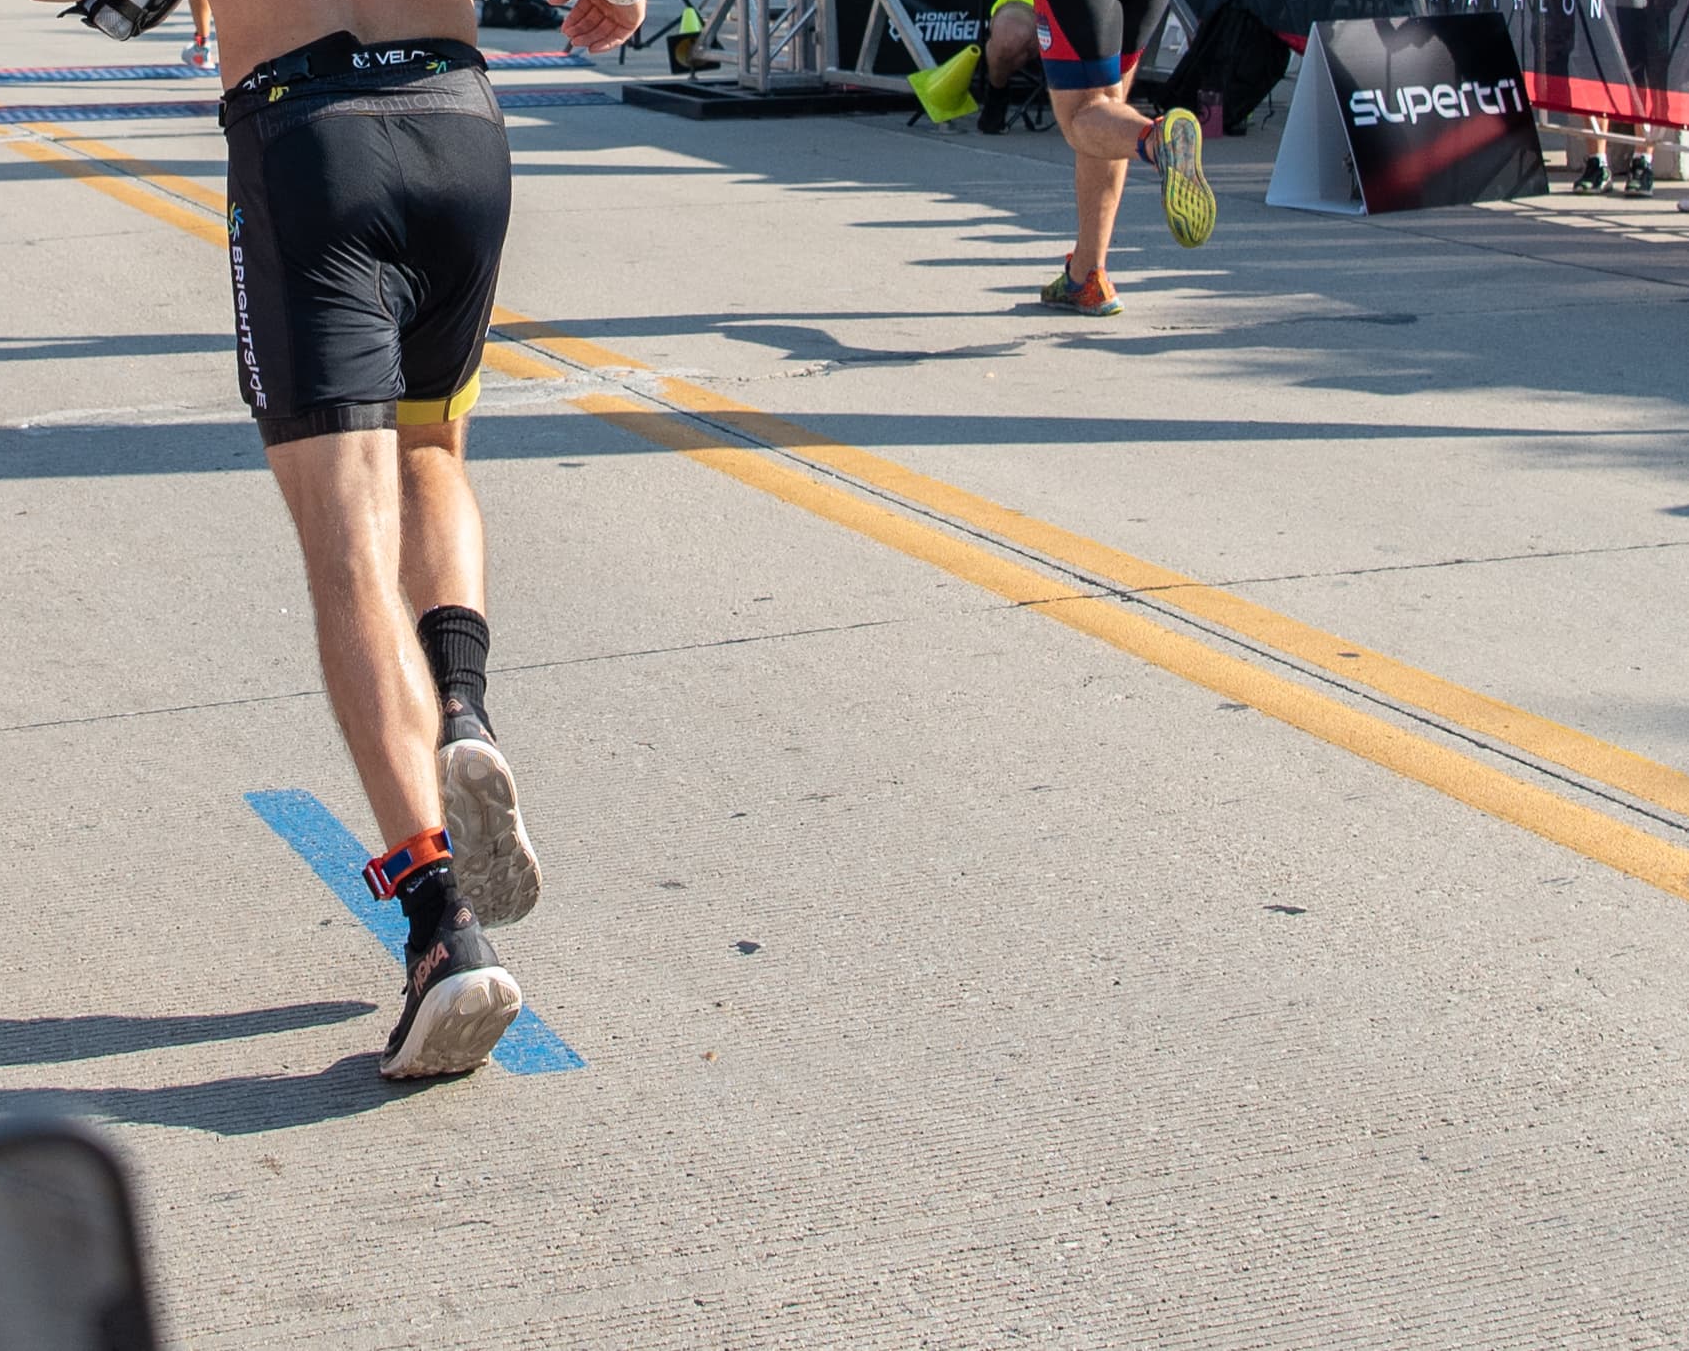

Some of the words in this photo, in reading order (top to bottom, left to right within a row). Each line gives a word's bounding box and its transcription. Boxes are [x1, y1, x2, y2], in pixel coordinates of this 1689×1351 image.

[915, 11, 969, 22] HONEY
[1349, 79, 1523, 127] supertri
[232, 245, 268, 410] BRIGHTSIDE
[413, 942, 450, 997] HOKA
